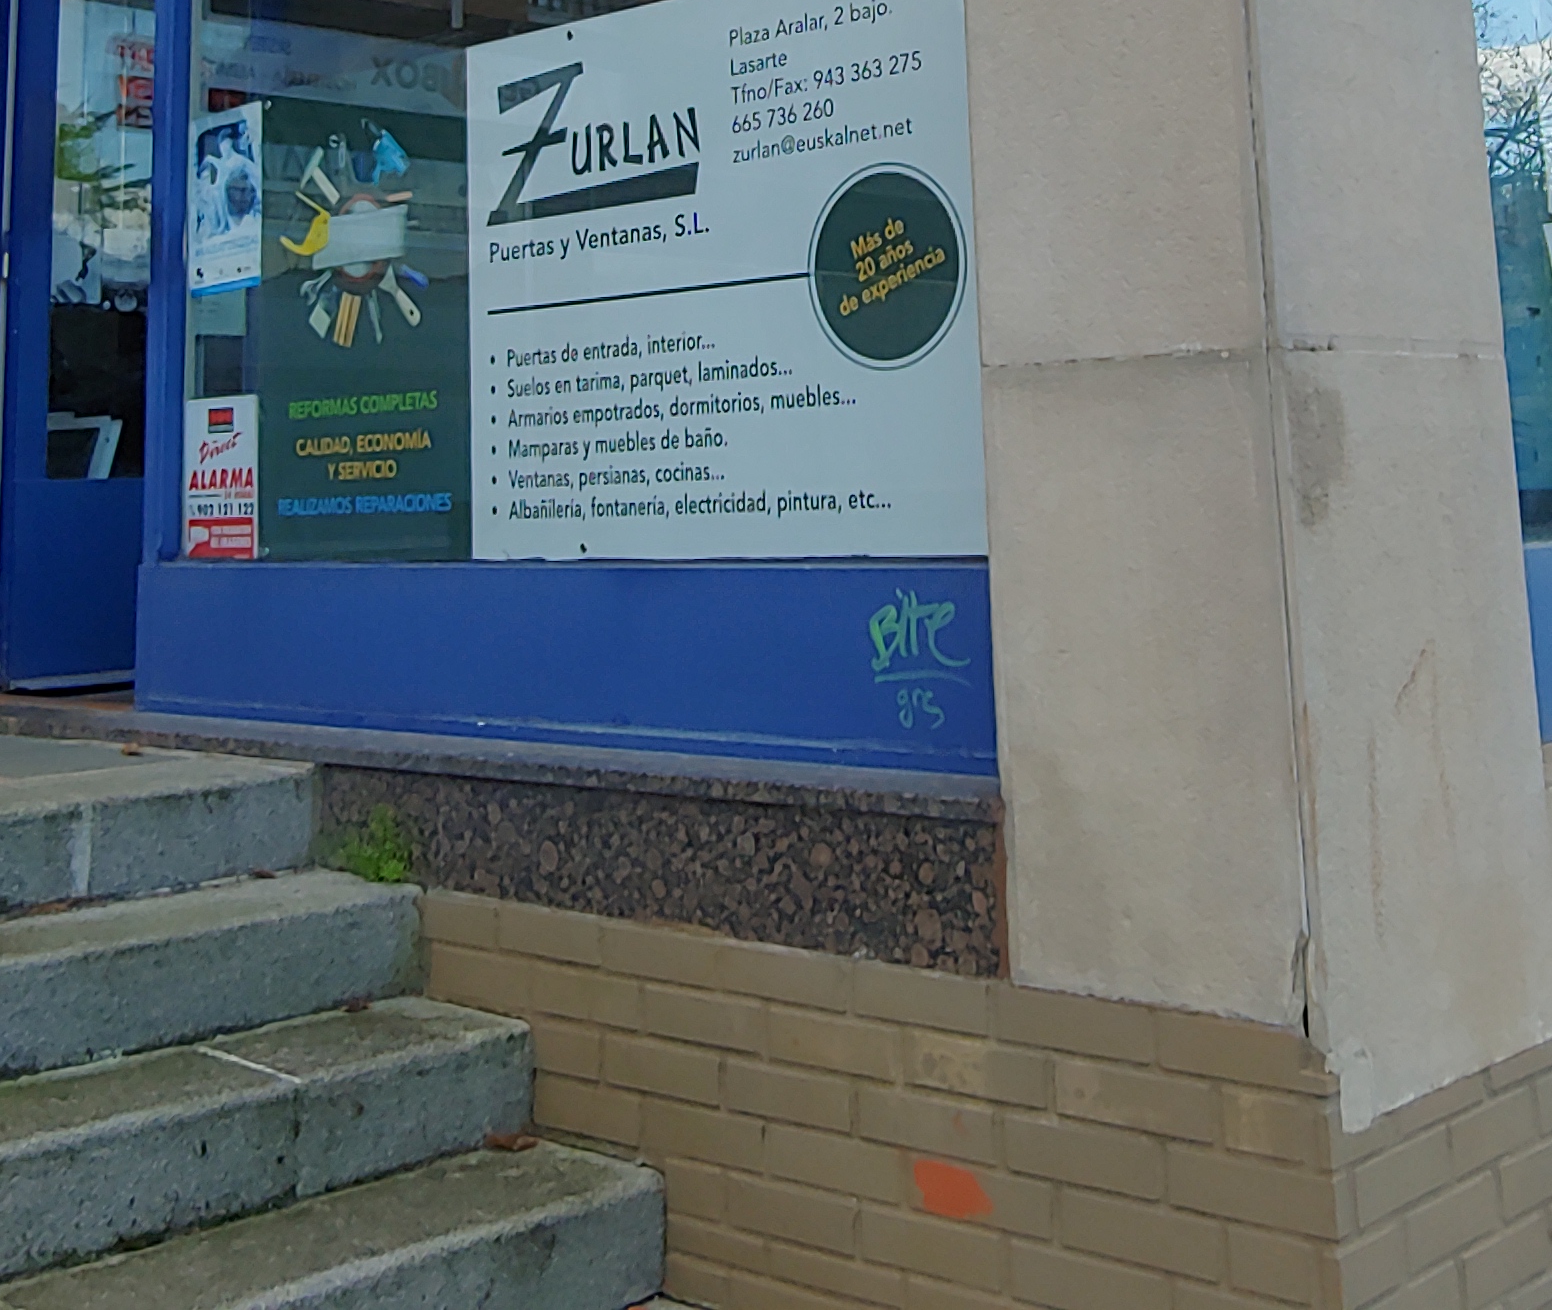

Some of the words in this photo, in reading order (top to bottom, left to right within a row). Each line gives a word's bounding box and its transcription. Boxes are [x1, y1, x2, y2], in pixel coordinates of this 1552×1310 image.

[729, 26, 770, 48] Plaza
[775, 12, 828, 39] Aralar,
[834, 6, 844, 25] 2
[730, 52, 788, 77] Lasarte
[730, 77, 809, 106] Tfno/Fax:
[813, 66, 845, 90] 943
[850, 58, 883, 82] 363
[888, 50, 923, 75] 275
[732, 111, 762, 134] 665
[767, 102, 798, 129] 736
[802, 98, 834, 122] 260
[485, 60, 701, 227] ZURLAN
[732, 117, 913, 164] zurlan@euskalnet.net
[489, 239, 555, 264] Puertas
[559, 237, 570, 260] y
[575, 223, 667, 251] Ventanas,
[674, 211, 710, 237] S.L.
[850, 231, 883, 260] Más
[884, 216, 905, 240] de
[855, 256, 876, 283] 20
[878, 239, 914, 270] años
[839, 293, 859, 317] de
[861, 245, 946, 305] experiencia
[506, 347, 557, 368] Puertas
[561, 341, 579, 363] de
[583, 333, 643, 360] entrada,
[647, 330, 716, 355] interior...
[506, 376, 551, 399] Suelos
[554, 378, 572, 394] en
[575, 371, 625, 393] tarima,
[630, 366, 693, 395] parquet,
[698, 354, 793, 383] laminados...
[288, 396, 358, 420] REFORMAS
[359, 390, 438, 414] COMPLETAS
[508, 406, 569, 429] Armarios
[572, 397, 664, 428] empotrados,
[669, 391, 765, 417] dormitorios,
[770, 383, 857, 410] muebles...
[295, 436, 353, 457] CALIDAD,
[356, 427, 432, 453] ECONOMÍA
[508, 438, 579, 464] Mamparas
[582, 438, 592, 462] y
[595, 429, 656, 454] muebles
[660, 427, 680, 451] de
[684, 426, 728, 449] baño.
[188, 467, 255, 492] ALARMA
[327, 462, 336, 480] Y
[337, 459, 398, 480] SERVICIO
[508, 468, 575, 491] Ventanas,
[578, 464, 650, 491] persianas,
[655, 460, 725, 483] cocinas...
[237, 501, 255, 516] 122
[277, 496, 354, 517] REALIZAMOS
[354, 492, 453, 515] REPARACIONES
[508, 497, 586, 522] Albañilería,
[591, 494, 670, 520] fontanería,
[675, 488, 772, 516] electricidad,
[777, 489, 843, 520] pintura,
[847, 489, 892, 510] etc...
